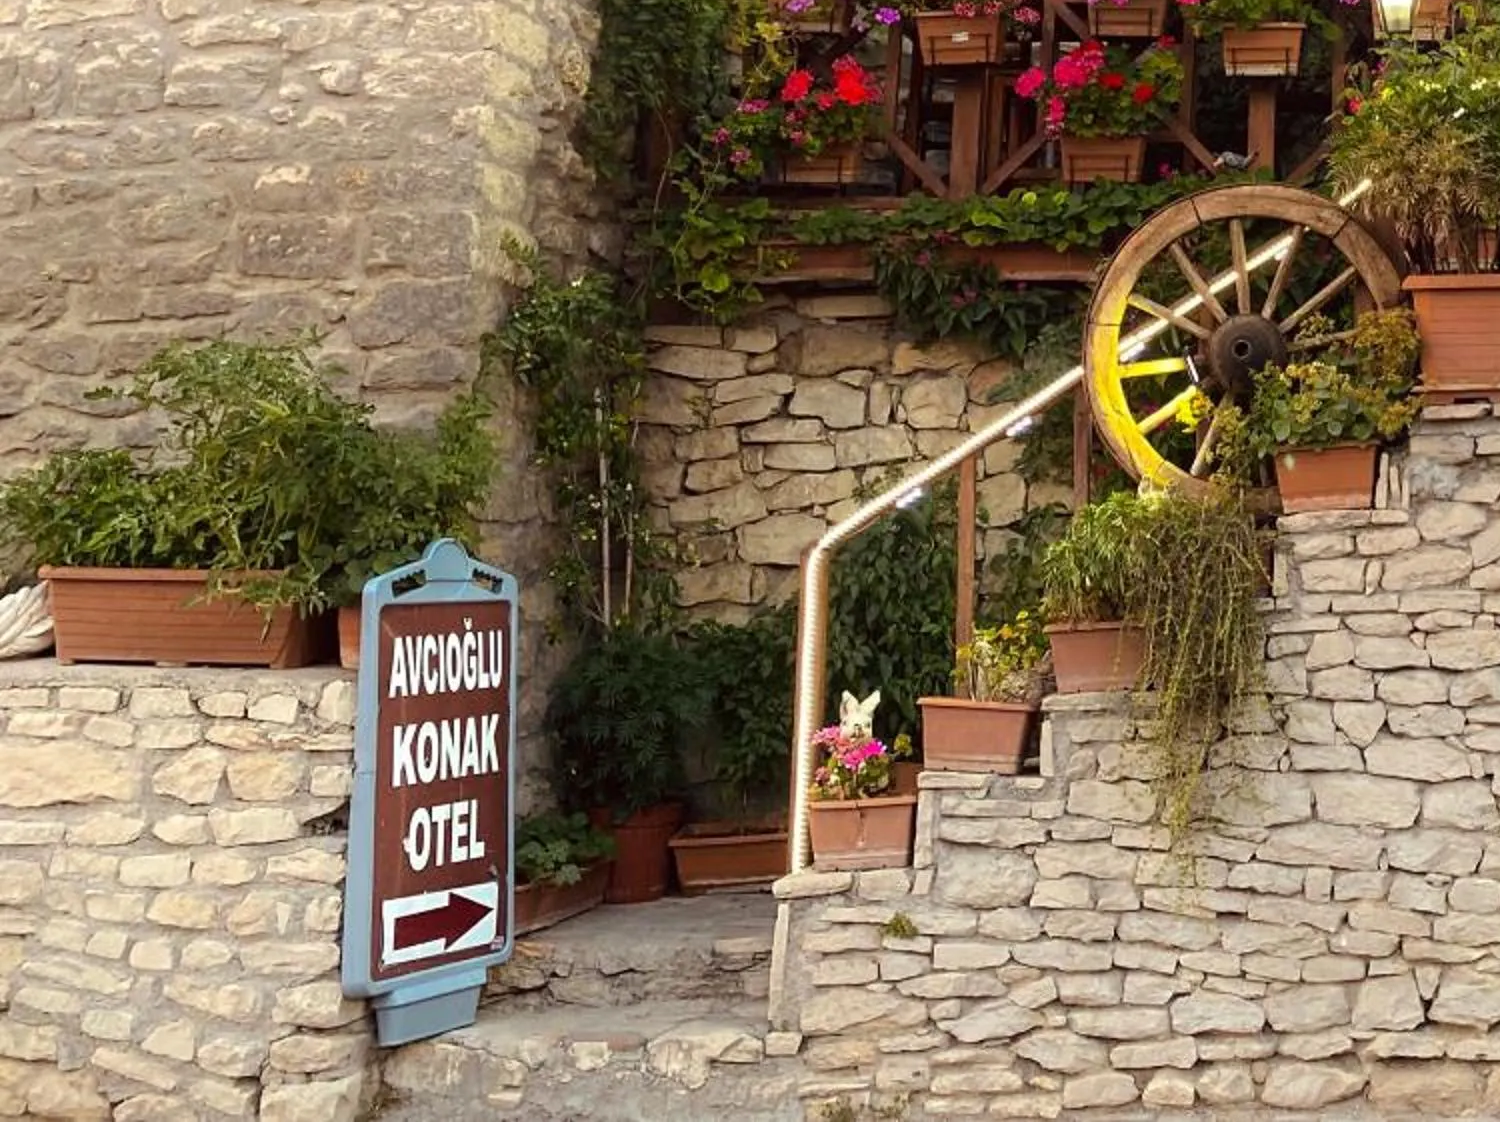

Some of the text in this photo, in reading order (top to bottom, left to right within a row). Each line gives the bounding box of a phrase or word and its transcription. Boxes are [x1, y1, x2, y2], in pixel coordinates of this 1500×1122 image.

[388, 617, 504, 699] AVCIOĞLU
[392, 713, 500, 788] KONAK
[408, 799, 486, 872] OTEL
